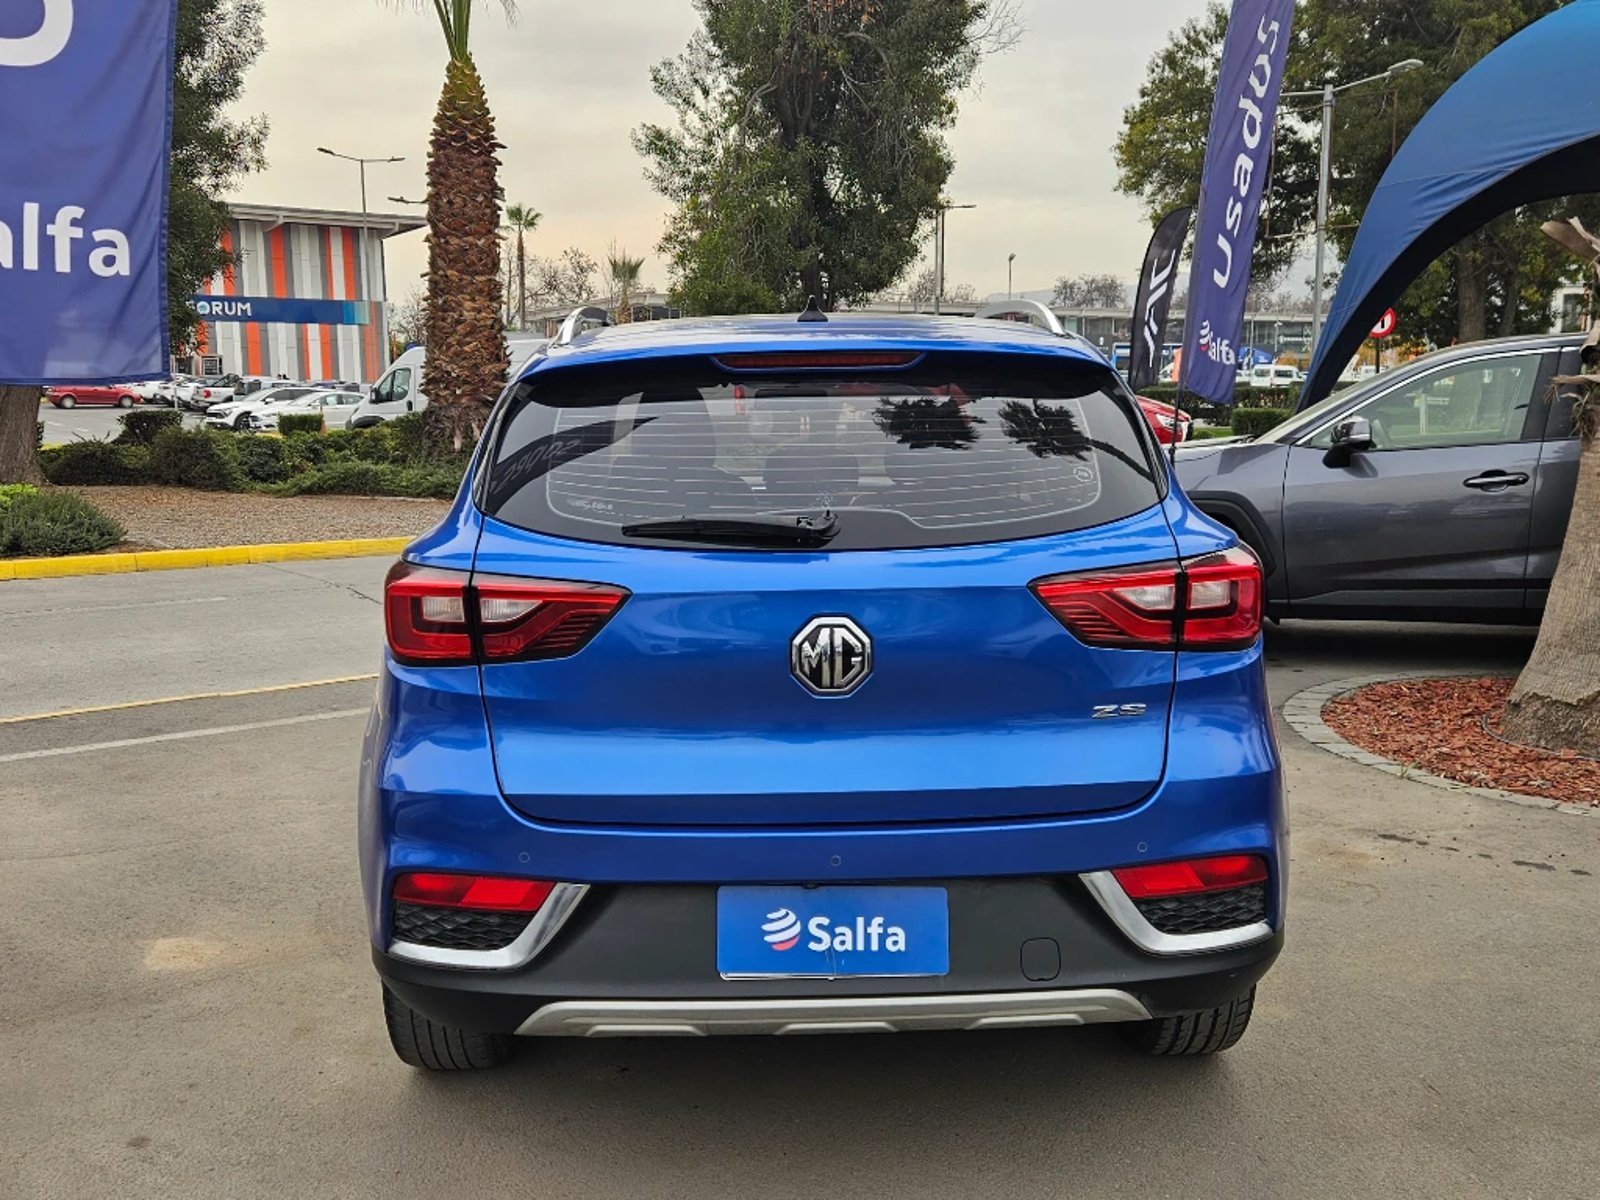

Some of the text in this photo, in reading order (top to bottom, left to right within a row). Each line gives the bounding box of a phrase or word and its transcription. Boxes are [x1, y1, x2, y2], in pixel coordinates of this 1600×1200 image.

[1213, 13, 1280, 289] Usados
[801, 627, 863, 688] MG
[1091, 703, 1147, 719] ZS
[807, 916, 906, 952] Salfa
